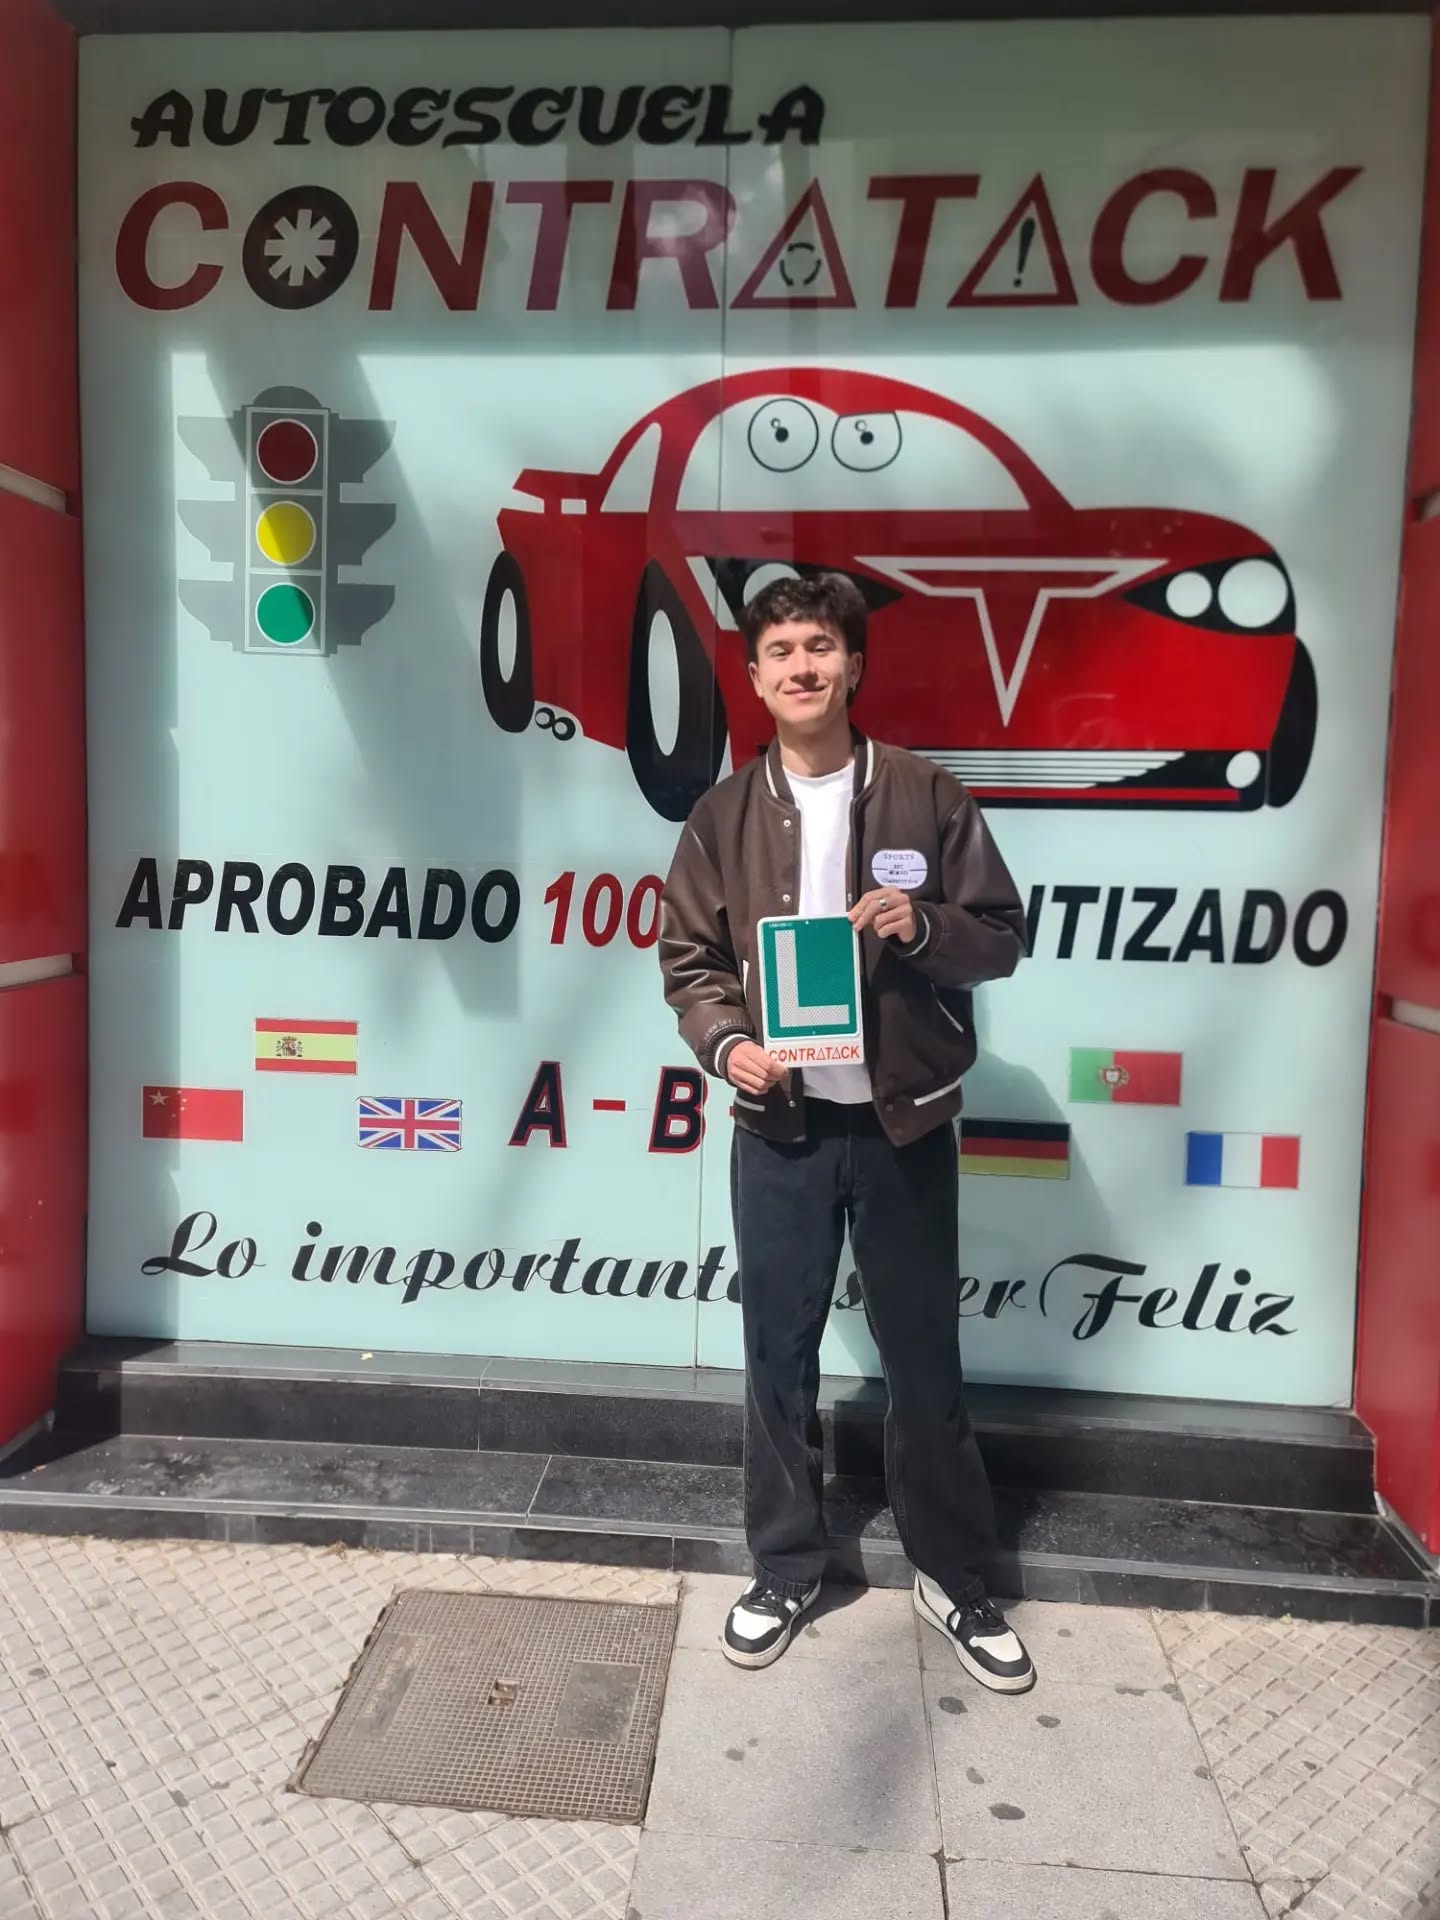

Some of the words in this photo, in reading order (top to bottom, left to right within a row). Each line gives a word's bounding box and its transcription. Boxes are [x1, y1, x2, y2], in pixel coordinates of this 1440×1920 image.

[130, 84, 825, 148] AUTOESCUELA
[115, 166, 1365, 311] CONTRATACK
[115, 857, 521, 944] APROBADO
[773, 929, 850, 1028] L
[509, 1061, 567, 1149] A
[648, 1065, 709, 1154] B
[141, 1210, 267, 1280] Lo
[957, 1275, 1027, 1319] er
[1039, 1252, 1299, 1341] Feliz
